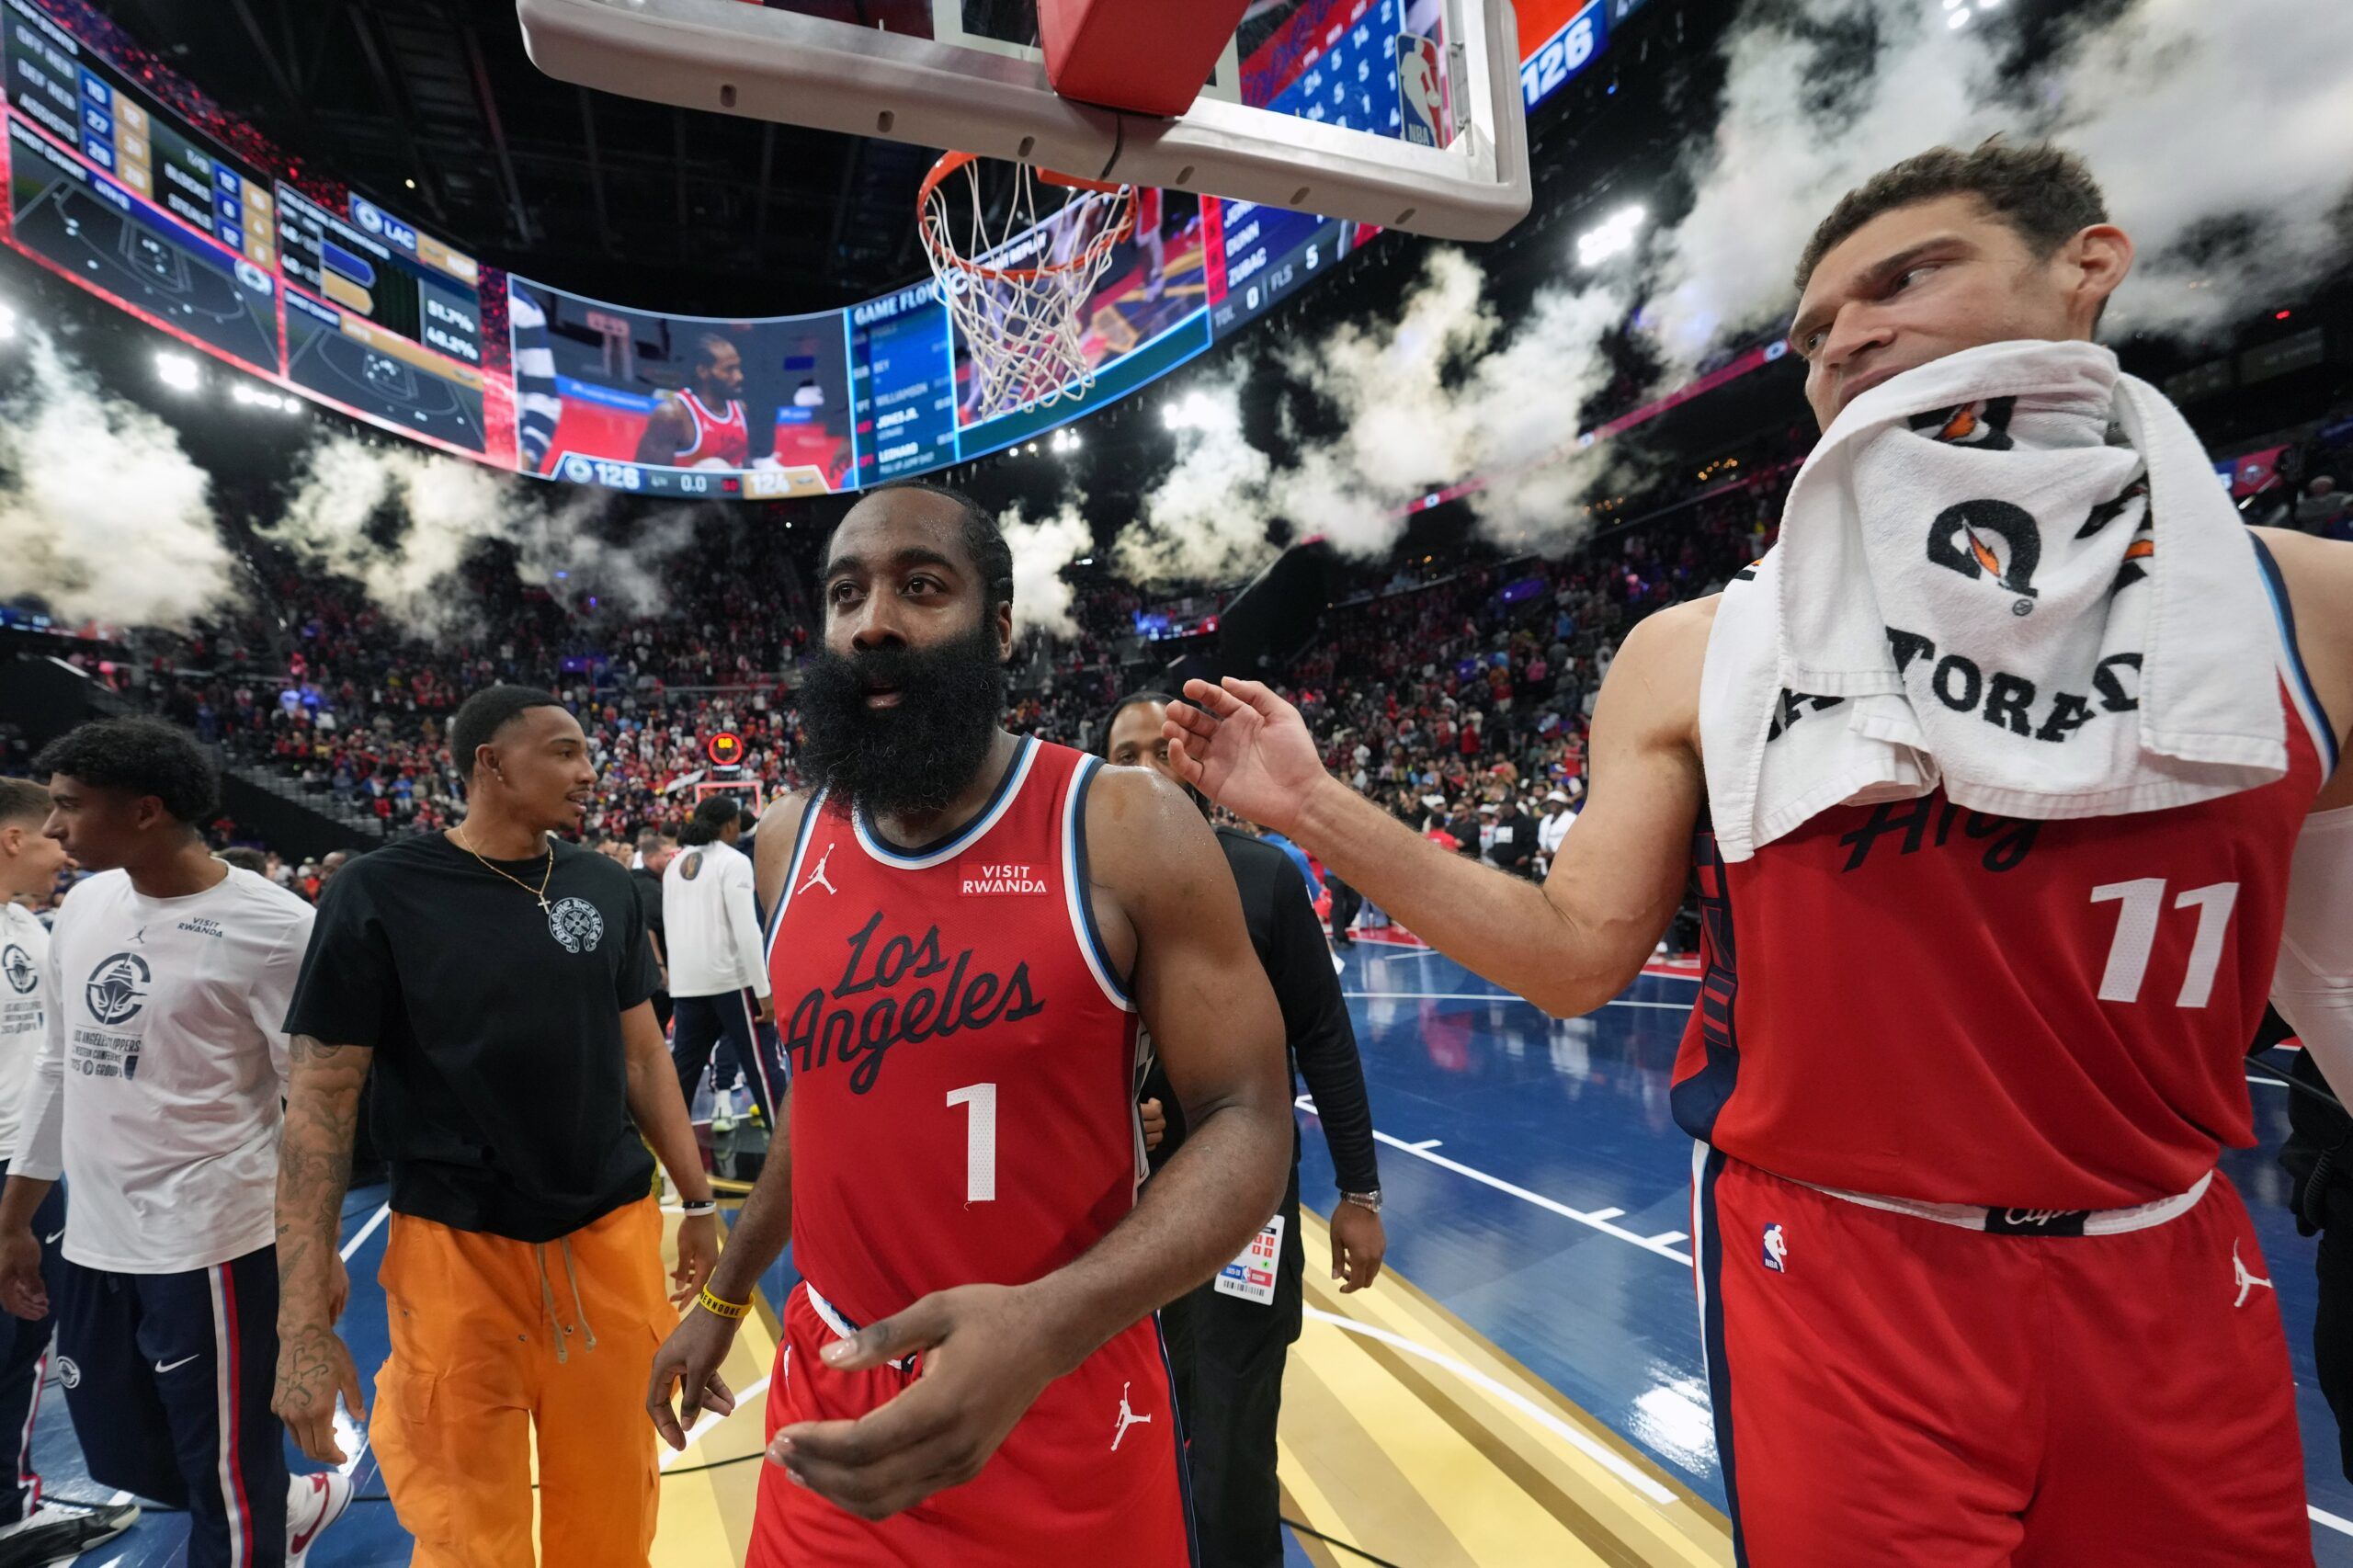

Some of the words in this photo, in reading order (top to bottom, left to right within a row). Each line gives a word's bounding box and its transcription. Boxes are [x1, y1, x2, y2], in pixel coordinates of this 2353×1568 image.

[1520, 17, 1594, 107] 126
[1387, 70, 1397, 91] 1
[1408, 123, 1430, 145] NBA
[1228, 246, 1267, 289] ZUBAC
[1246, 286, 1260, 311] 0
[1305, 243, 1319, 270] 5
[854, 295, 899, 326] GAME
[962, 880, 1047, 893] RWANDA
[982, 865, 1030, 879] VISIT
[177, 922, 223, 938] RWANDA
[193, 916, 221, 928] VISIT
[831, 910, 950, 1000] Los
[2090, 878, 2240, 1008] 11
[784, 949, 1046, 1096] Angeles
[947, 1083, 996, 1201] 1
[1765, 1258, 1779, 1270] NBA
